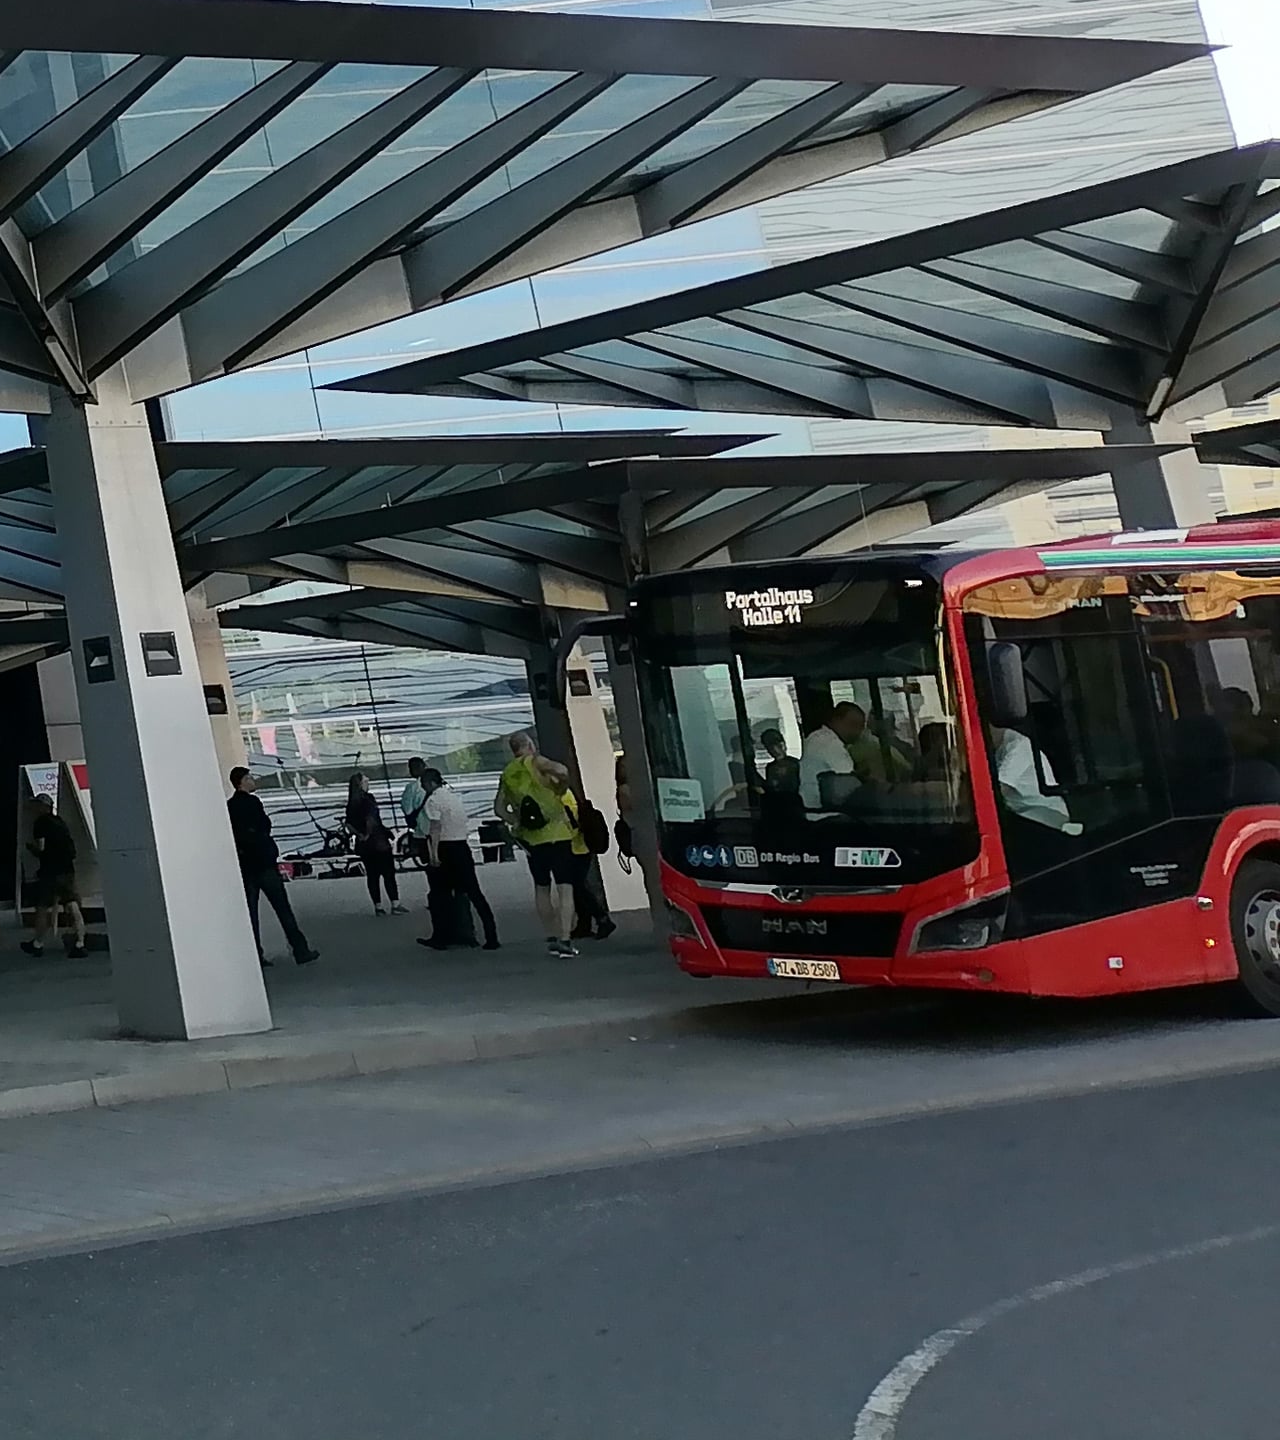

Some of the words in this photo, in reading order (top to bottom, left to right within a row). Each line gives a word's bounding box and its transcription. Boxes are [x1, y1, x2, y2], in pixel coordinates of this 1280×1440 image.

[725, 587, 814, 610] Portalhaus
[742, 606, 784, 627] Halle
[784, 605, 802, 624] 11
[738, 850, 756, 864] DB
[760, 852, 774, 862] DB
[802, 852, 821, 863] Bus
[848, 848, 891, 866] RMV
[762, 918, 828, 935] MAN
[775, 961, 790, 975] MZ
[795, 962, 810, 976] DB
[810, 963, 838, 978] 2589
